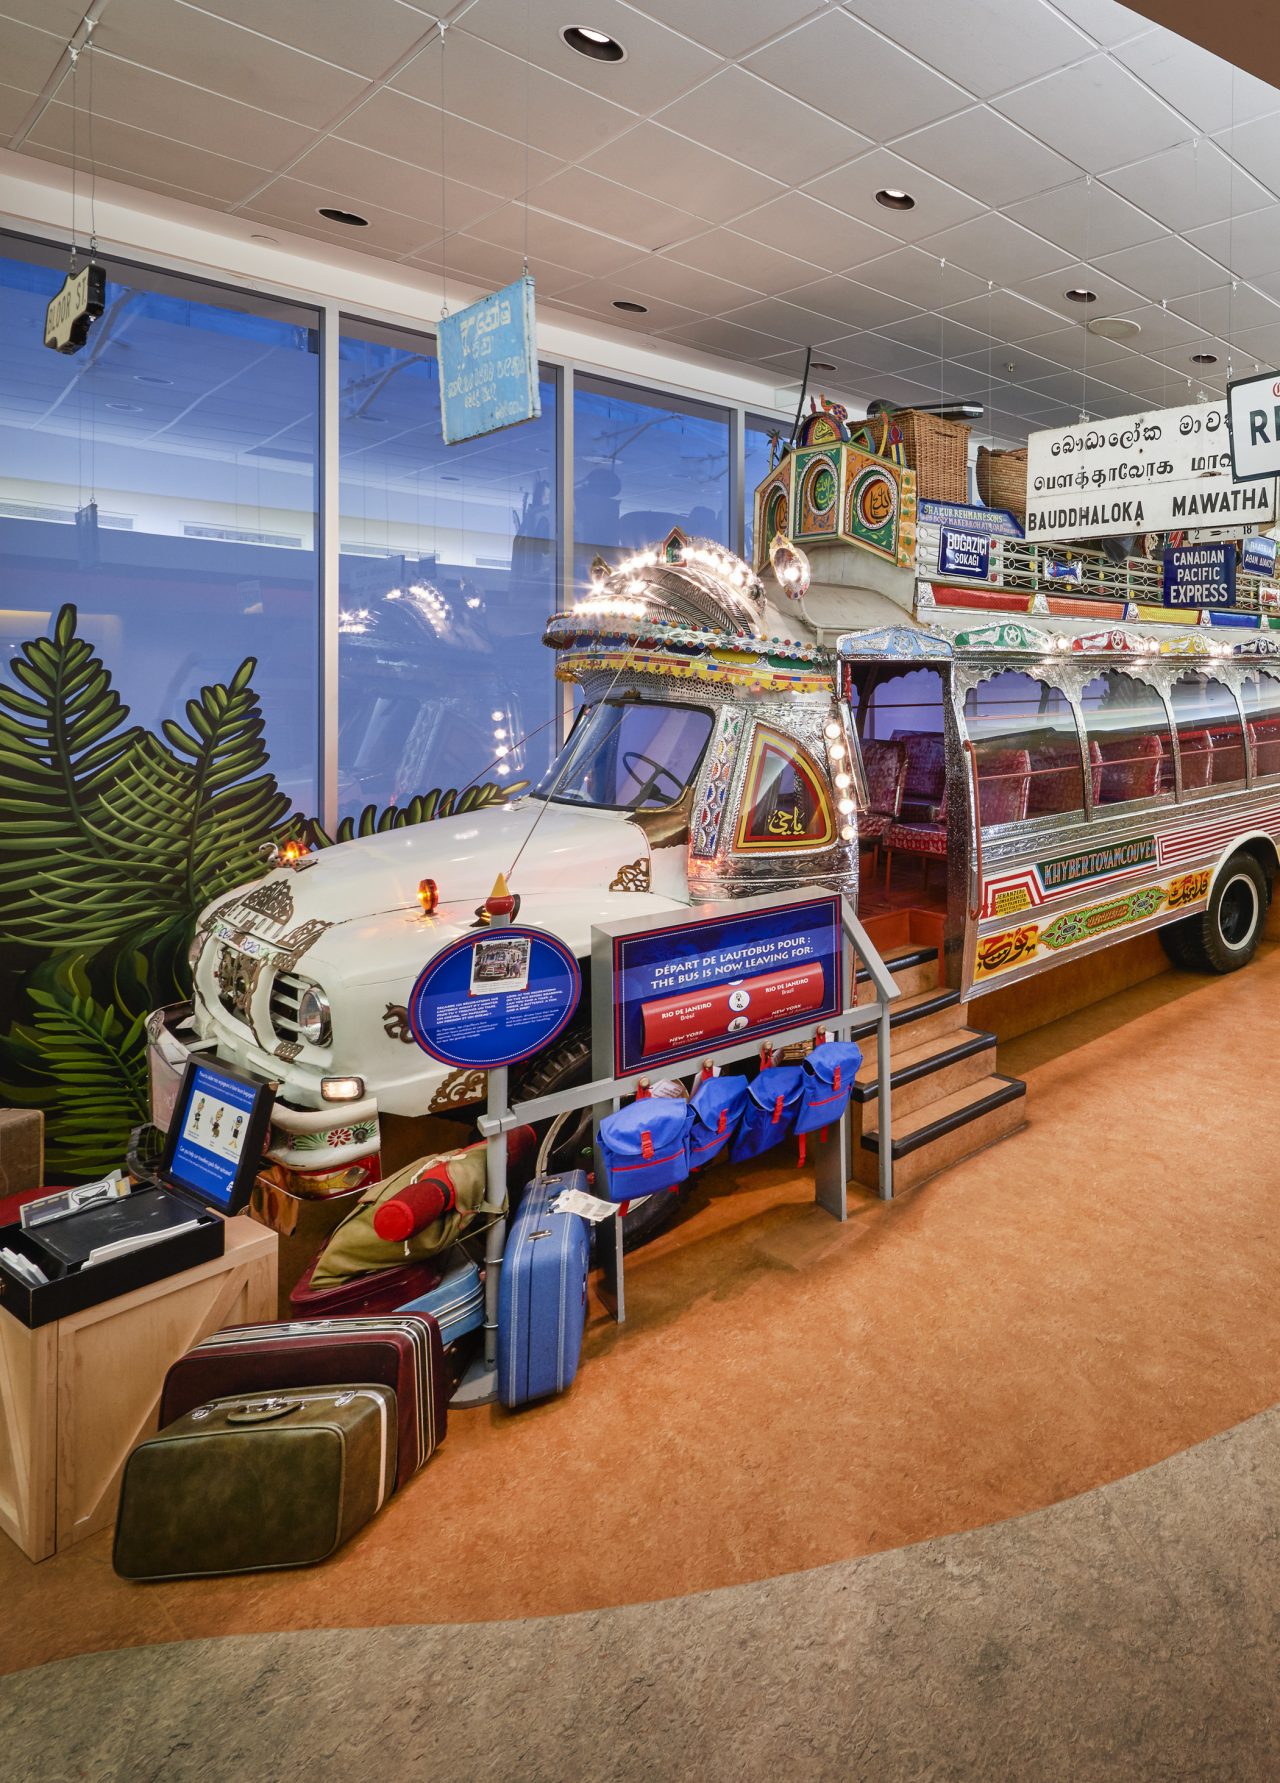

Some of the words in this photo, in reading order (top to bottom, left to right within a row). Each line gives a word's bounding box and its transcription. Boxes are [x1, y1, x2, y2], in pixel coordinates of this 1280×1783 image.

[48, 291, 71, 335] BLOOR
[1028, 501, 1144, 532] BAUDDHALOKA
[1171, 486, 1269, 518] MAWATHA
[1242, 525, 1253, 535] 18
[1173, 550, 1225, 566] CANADIAN
[1177, 567, 1220, 582] PACIFIC
[1170, 584, 1228, 604] EXPRESS
[655, 959, 700, 977] DÉPART
[702, 955, 716, 966] DE
[720, 943, 775, 963] L'AUTOBUS
[777, 937, 805, 950] POUR
[651, 977, 674, 990] THE
[678, 972, 699, 984] BUS
[702, 968, 712, 978] IS
[715, 962, 744, 976] NOW
[745, 951, 789, 969] LEAVING
[791, 946, 813, 958] FOR:
[765, 985, 777, 993] RIO
[777, 983, 784, 991] DE
[785, 978, 809, 990] JANEIRO
[661, 1011, 674, 1020] RIO
[676, 1008, 683, 1016] DE
[685, 1002, 712, 1015] JANEIRO
